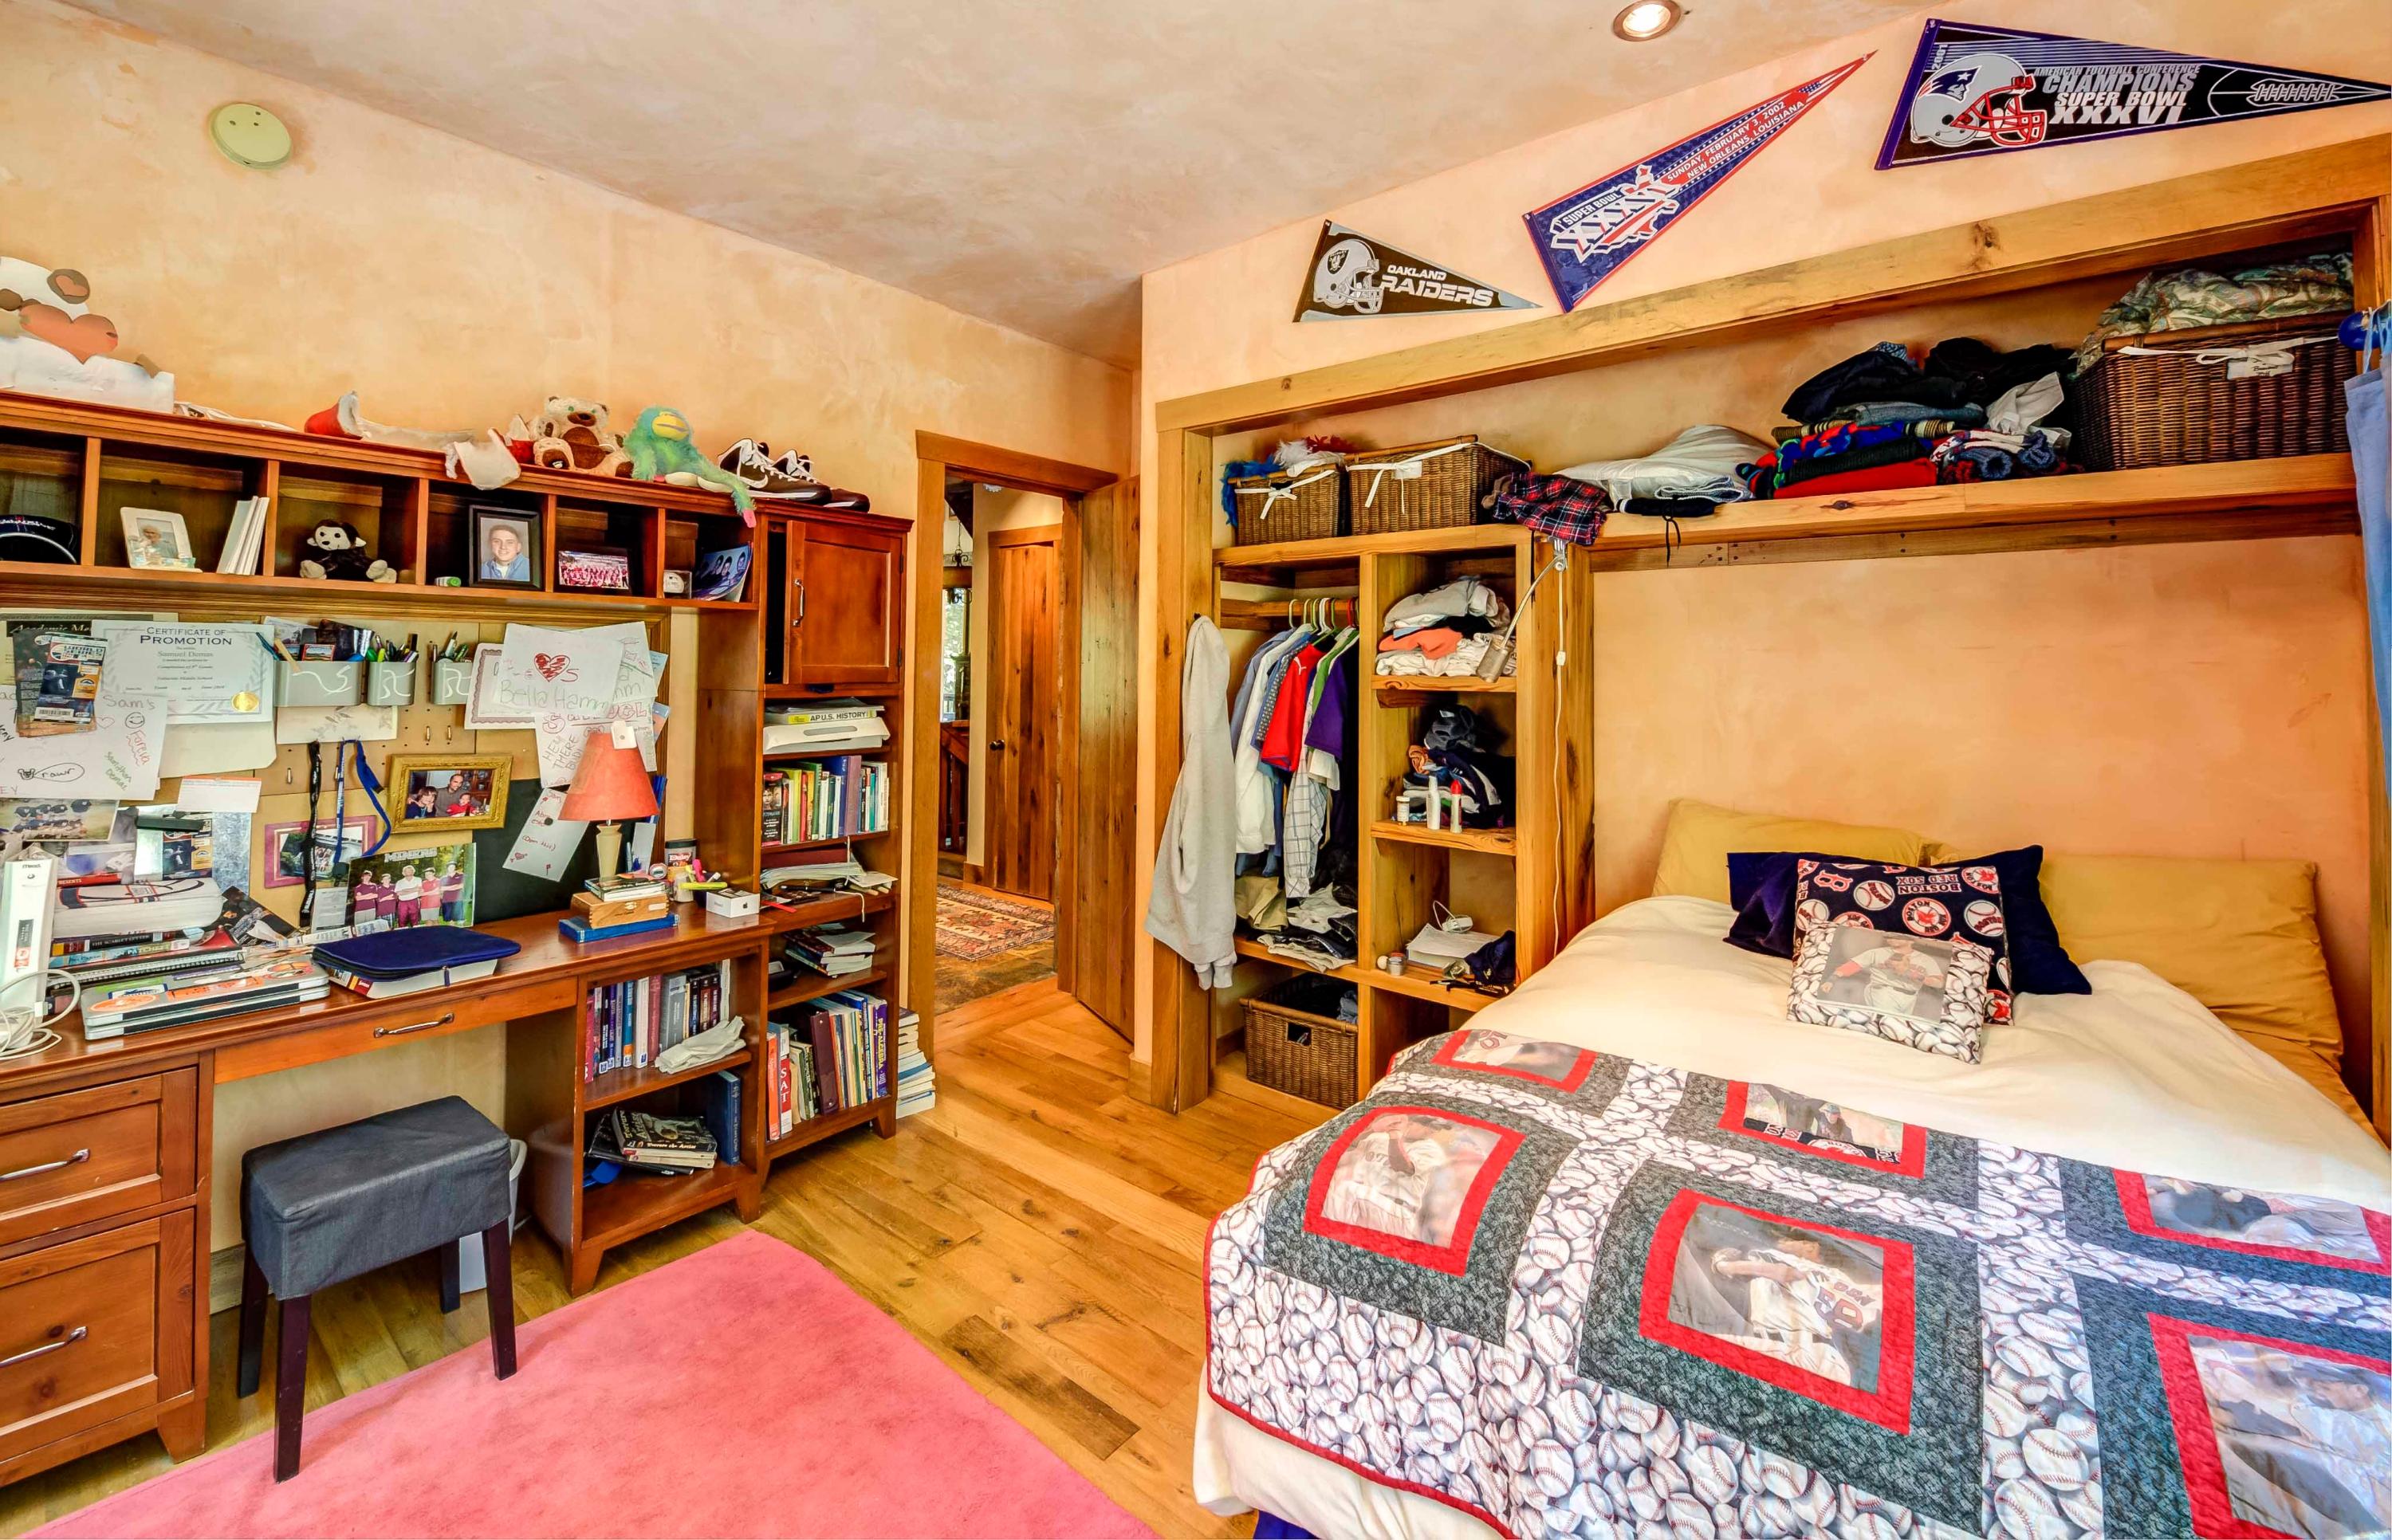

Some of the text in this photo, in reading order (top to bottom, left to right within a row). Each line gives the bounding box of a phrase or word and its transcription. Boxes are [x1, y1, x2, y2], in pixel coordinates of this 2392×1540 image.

[1931, 44, 1948, 69] 2001
[2034, 65, 2201, 77] AMERICAN FOOTBALL CONFERENCE
[2042, 73, 2197, 94] CHAMPIONS
[2054, 91, 2188, 107] SUPER BOWL
[2048, 105, 2184, 124] XXXVI
[1667, 155, 1705, 182] SUNDAY,
[1705, 125, 1751, 157] FEBRUARY
[1762, 101, 1786, 120] 2002
[1686, 100, 1805, 179] NEW ORLEANS, LOUISIANA
[1562, 191, 1622, 226] SUPER BOWL
[1387, 265, 1447, 281] OAKLAND
[1380, 274, 1494, 307] RAIDERS
[140, 634, 232, 645] PROMOTION
[500, 679, 548, 709] Bella
[1895, 874, 1957, 886] RED SOX
[1898, 882, 1961, 894] BOSTON
[780, 1067, 789, 1103] SAT
